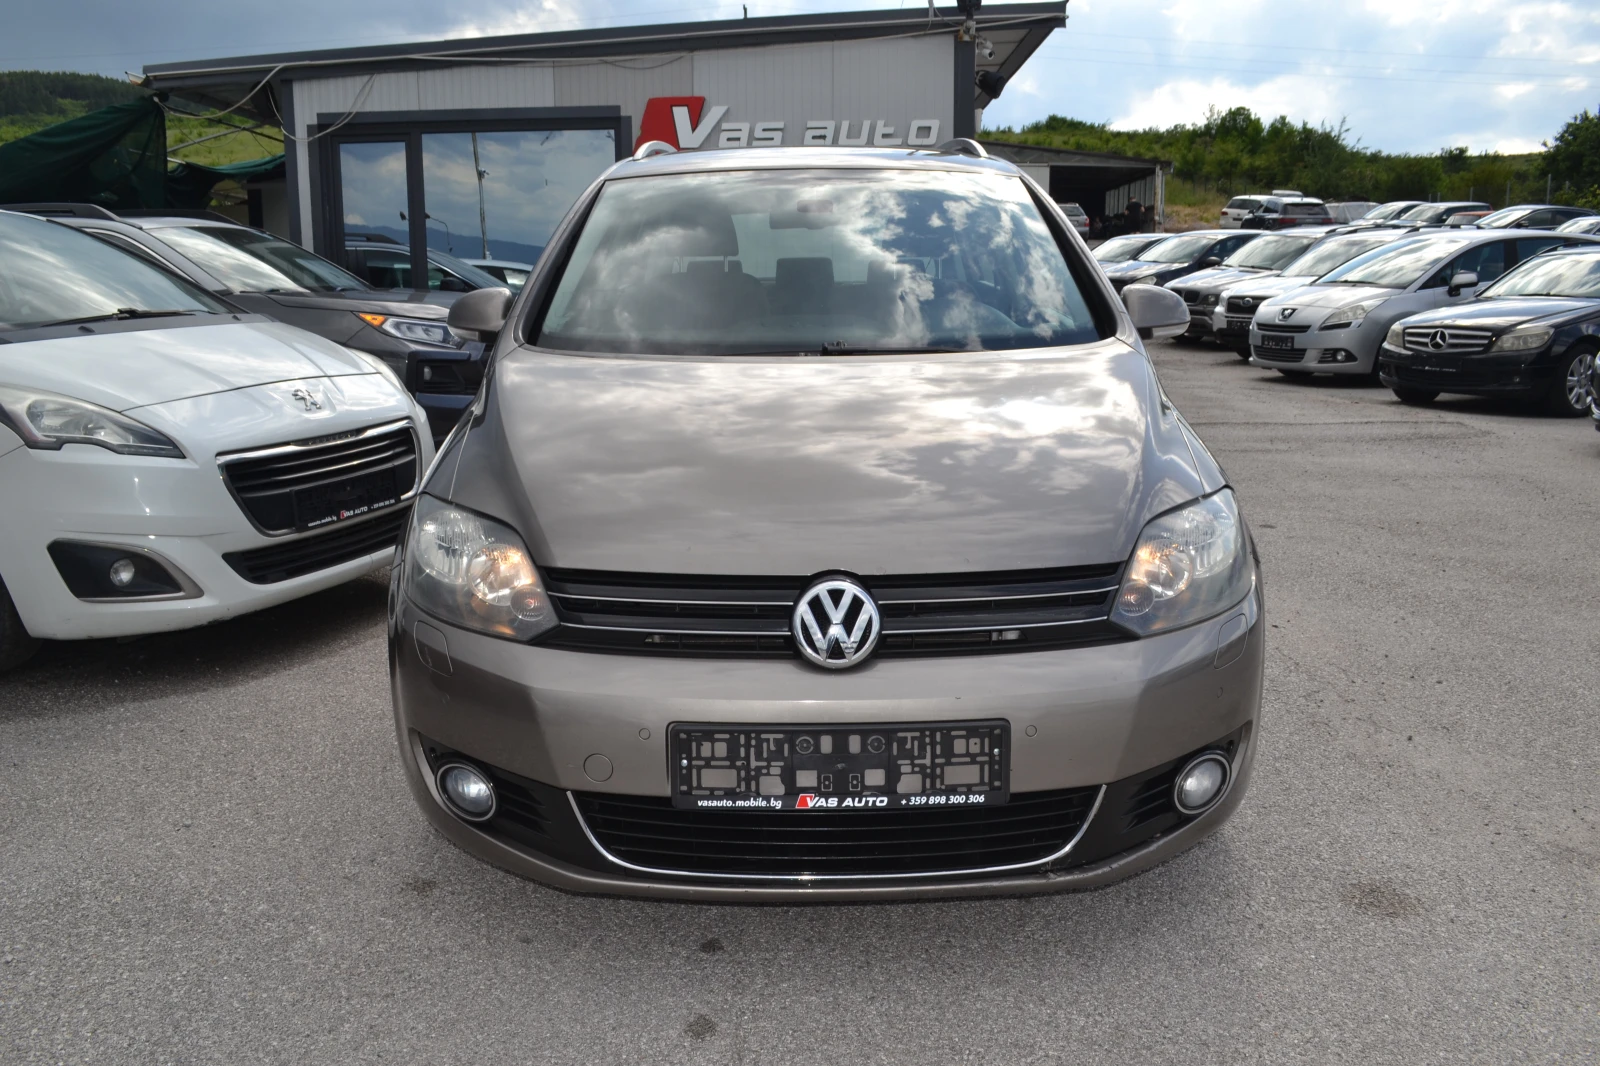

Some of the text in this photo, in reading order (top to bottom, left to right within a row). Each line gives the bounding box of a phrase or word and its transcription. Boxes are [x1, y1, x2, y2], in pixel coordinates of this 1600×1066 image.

[354, 506, 368, 514] AUTO
[697, 797, 783, 809] vasauto.mobile.bg
[805, 796, 888, 808] VAS AUTO
[928, 796, 946, 805] 898
[948, 795, 966, 804] 300
[967, 794, 985, 803] 306
